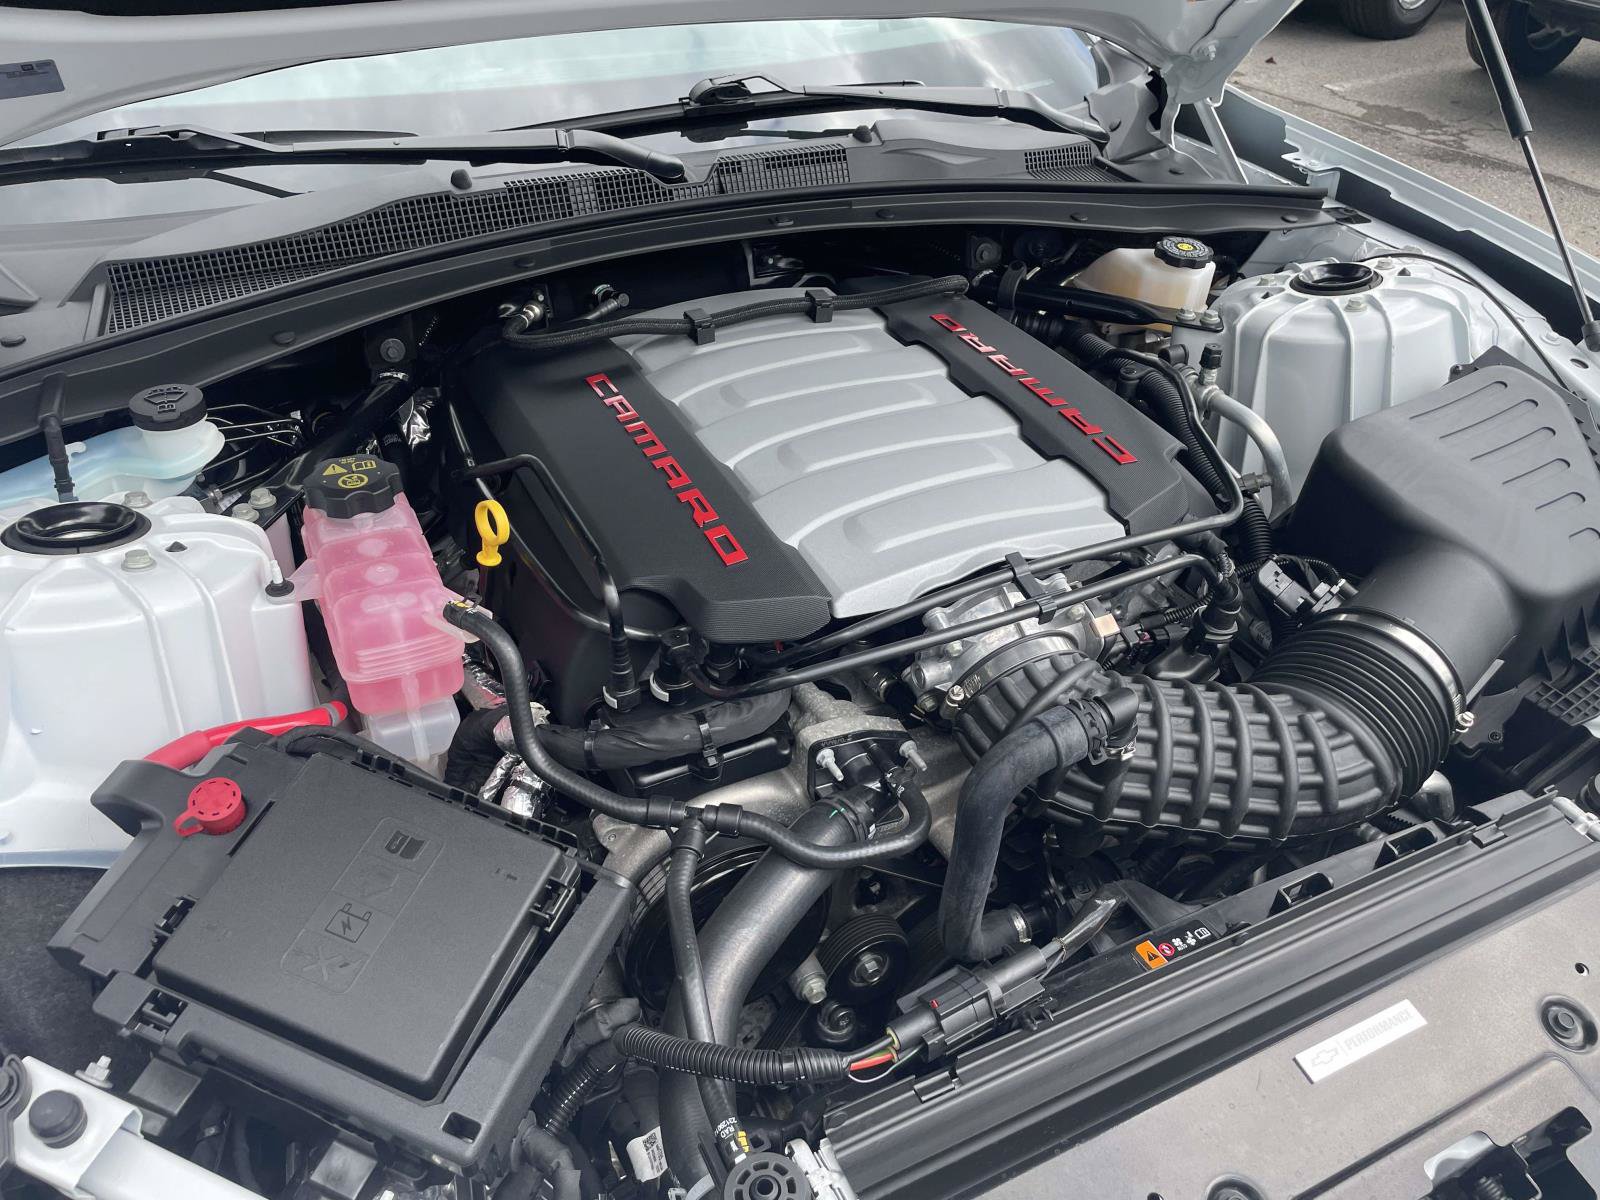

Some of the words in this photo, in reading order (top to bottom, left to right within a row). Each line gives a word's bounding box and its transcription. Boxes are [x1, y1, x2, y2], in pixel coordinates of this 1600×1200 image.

[929, 312, 1138, 465] CAMARO
[585, 372, 749, 567] CAMARO
[1344, 1008, 1414, 1051] PERFORMANCE
